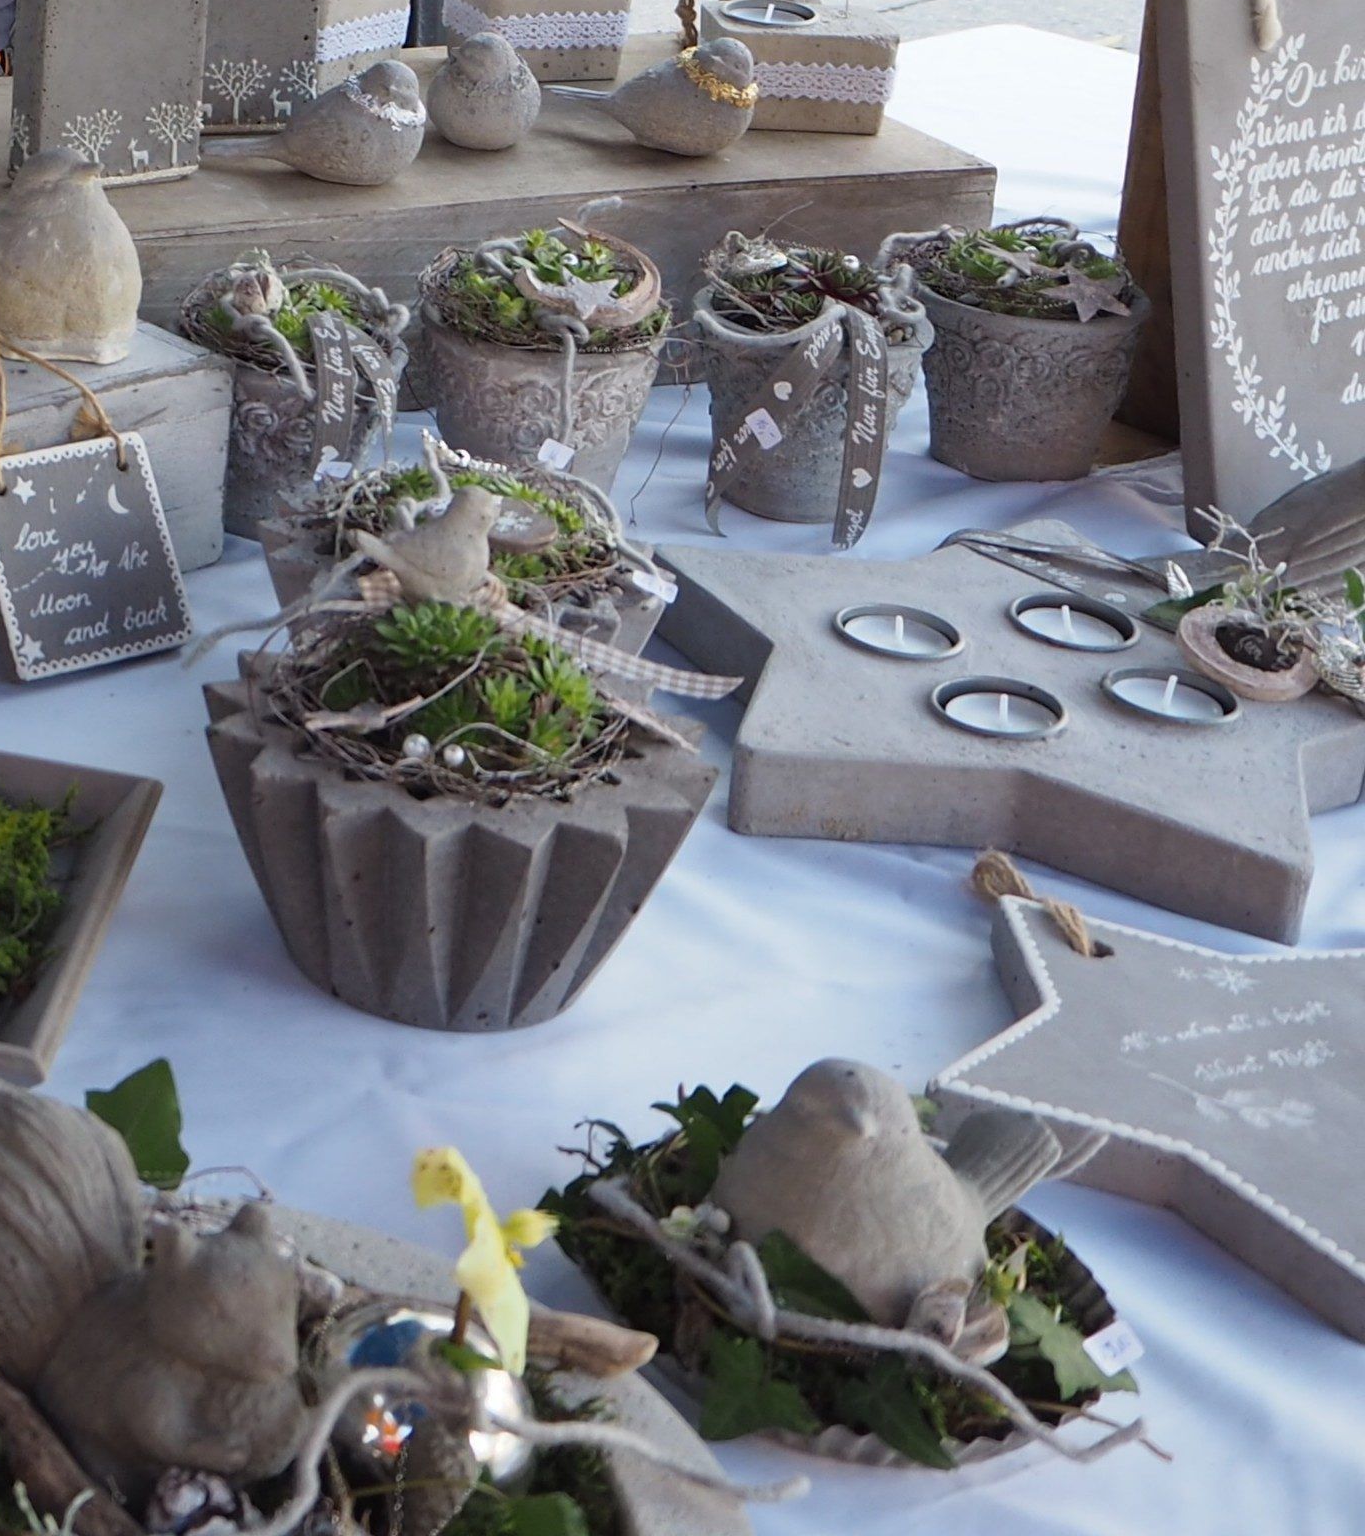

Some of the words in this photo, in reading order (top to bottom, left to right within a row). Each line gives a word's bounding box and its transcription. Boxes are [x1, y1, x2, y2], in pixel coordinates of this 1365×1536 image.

[1285, 61, 1327, 108] Du
[1256, 114, 1317, 148] Wenn
[1320, 102, 1348, 138] ich
[1247, 184, 1282, 217] ich
[1250, 212, 1292, 247] dich
[1317, 225, 1362, 262] dich
[1310, 296, 1340, 345] für
[323, 345, 353, 377] für
[857, 365, 887, 400] für
[321, 379, 347, 425] Nur
[851, 402, 878, 445] Nur
[13, 521, 60, 552] love
[52, 539, 96, 575] you
[117, 540, 150, 571] the
[64, 610, 110, 646] and
[122, 596, 169, 631] back
